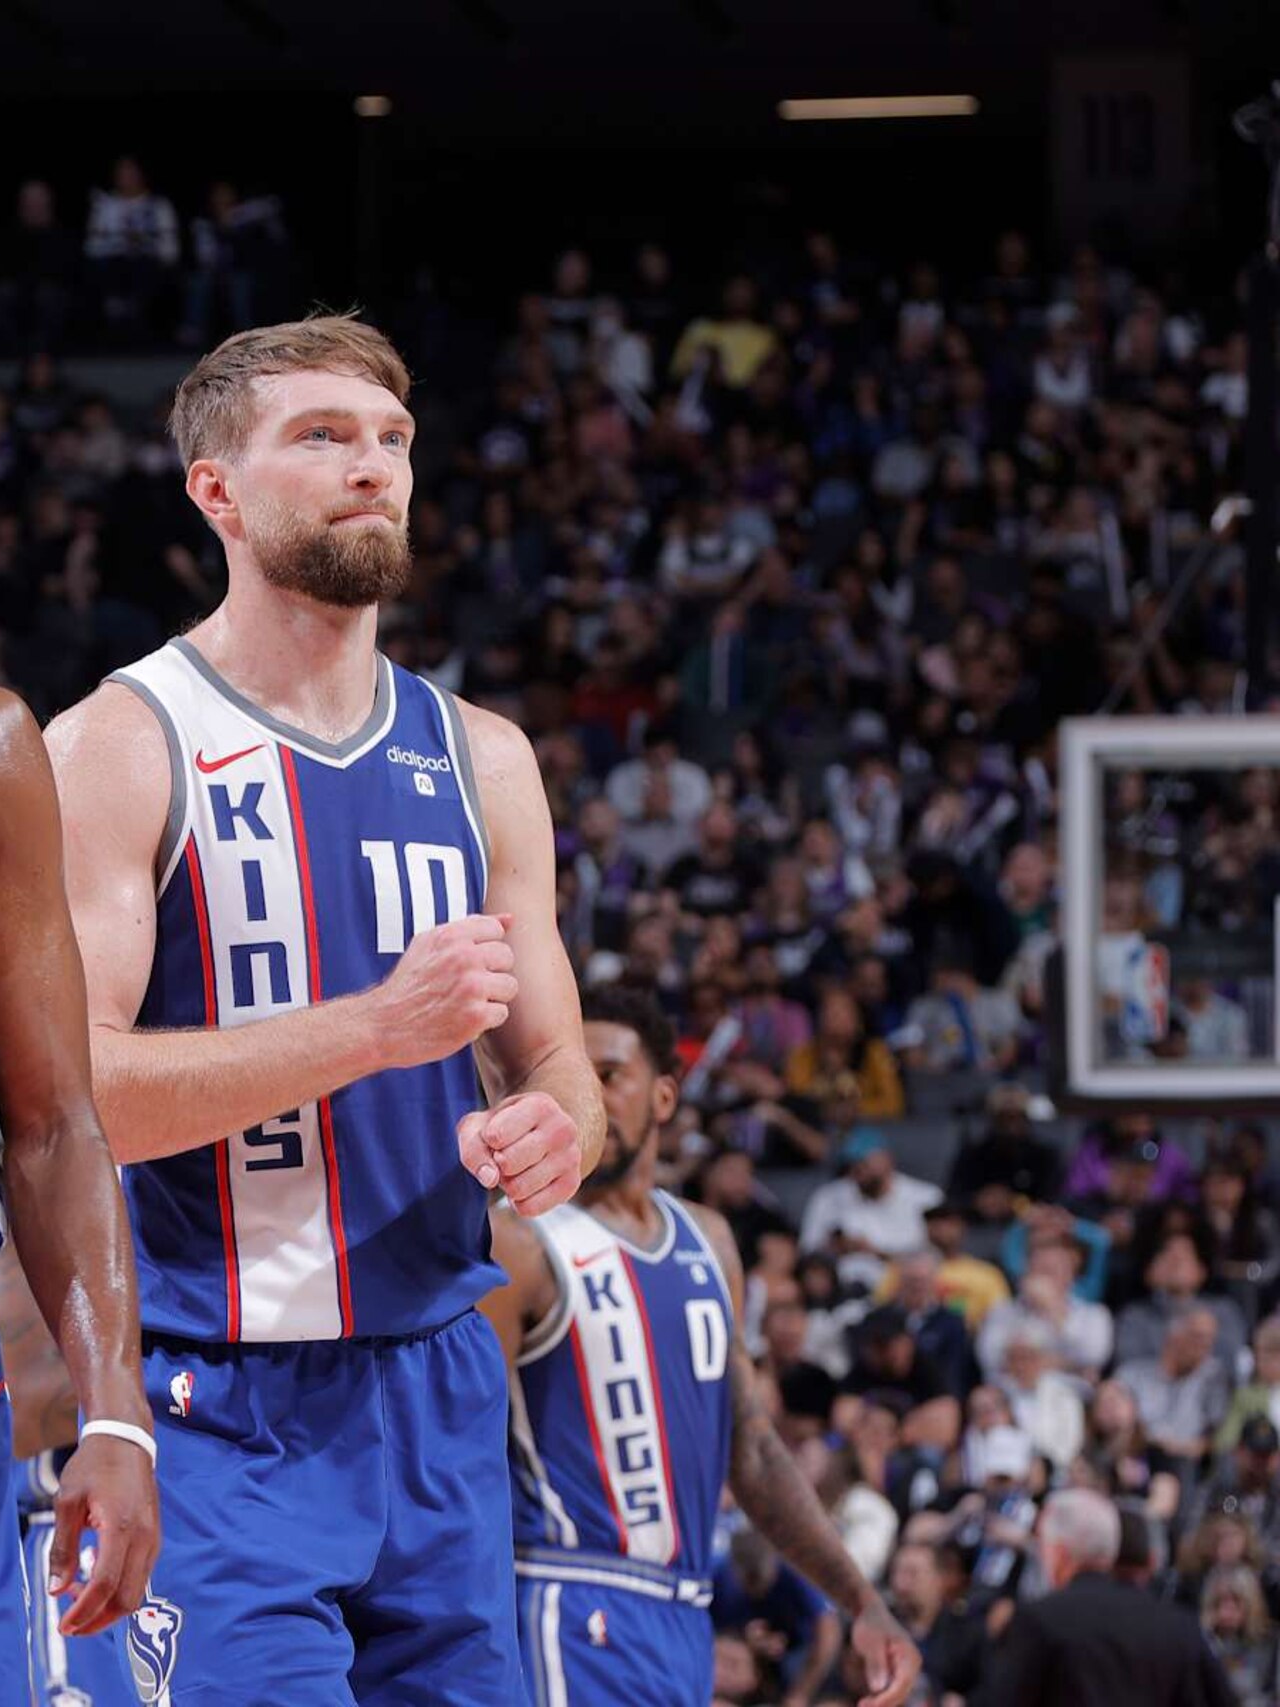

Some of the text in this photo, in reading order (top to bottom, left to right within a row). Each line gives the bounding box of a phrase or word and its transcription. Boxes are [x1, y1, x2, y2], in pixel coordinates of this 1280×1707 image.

[386, 745, 452, 772] dialpad
[361, 840, 468, 954] 10
[207, 782, 304, 1171] KINS
[685, 1299, 728, 1382] 0
[583, 1272, 661, 1526] KINGS
